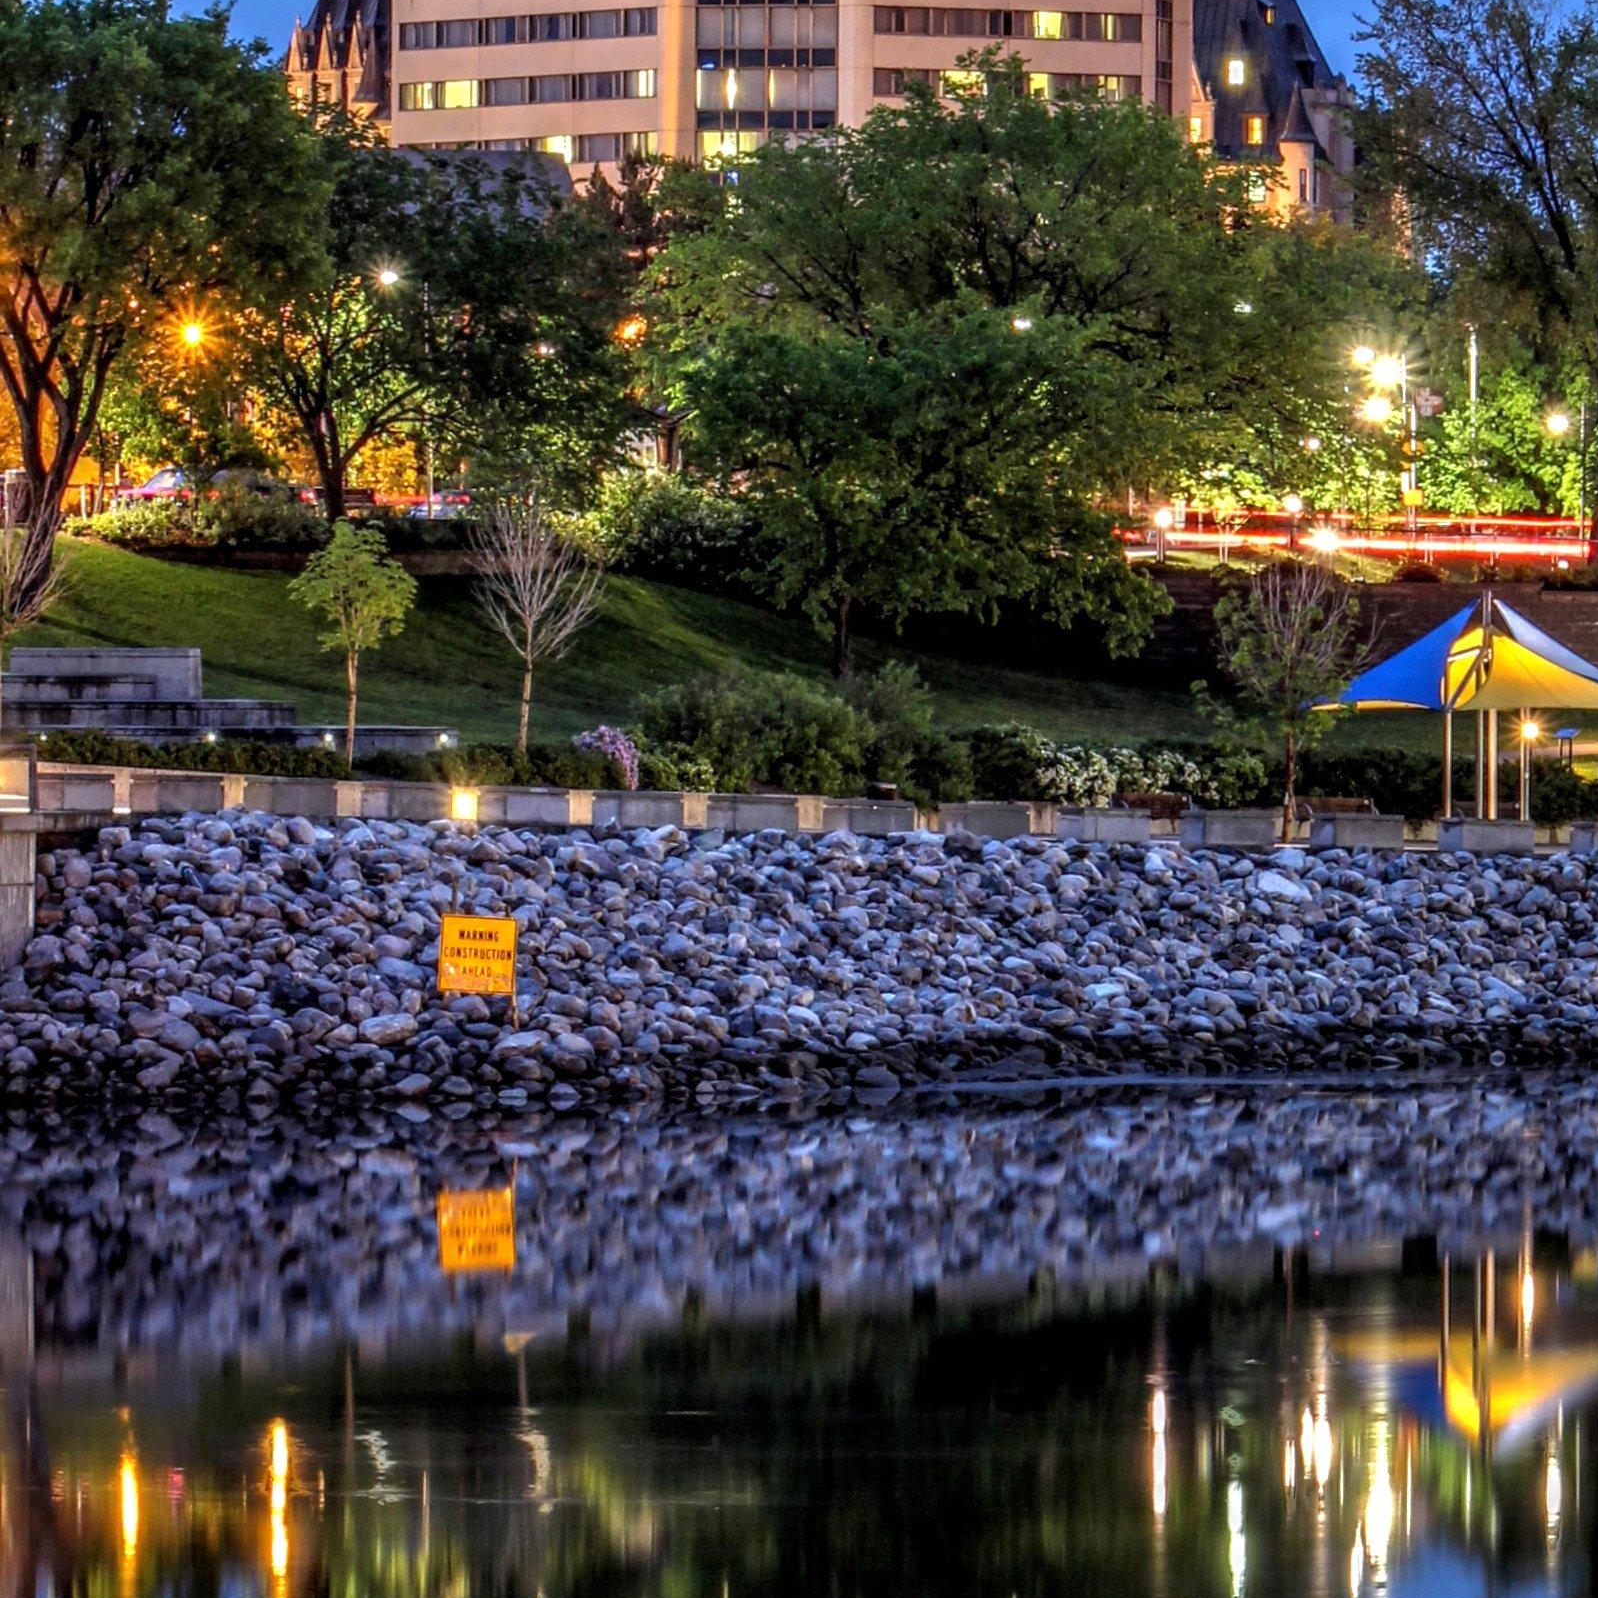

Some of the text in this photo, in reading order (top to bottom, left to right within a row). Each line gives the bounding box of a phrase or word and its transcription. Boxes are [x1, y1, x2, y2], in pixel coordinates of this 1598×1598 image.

[458, 929, 500, 943] WARNING
[443, 946, 512, 961] CONSTRUCTION
[462, 966, 492, 978] AHEAD
